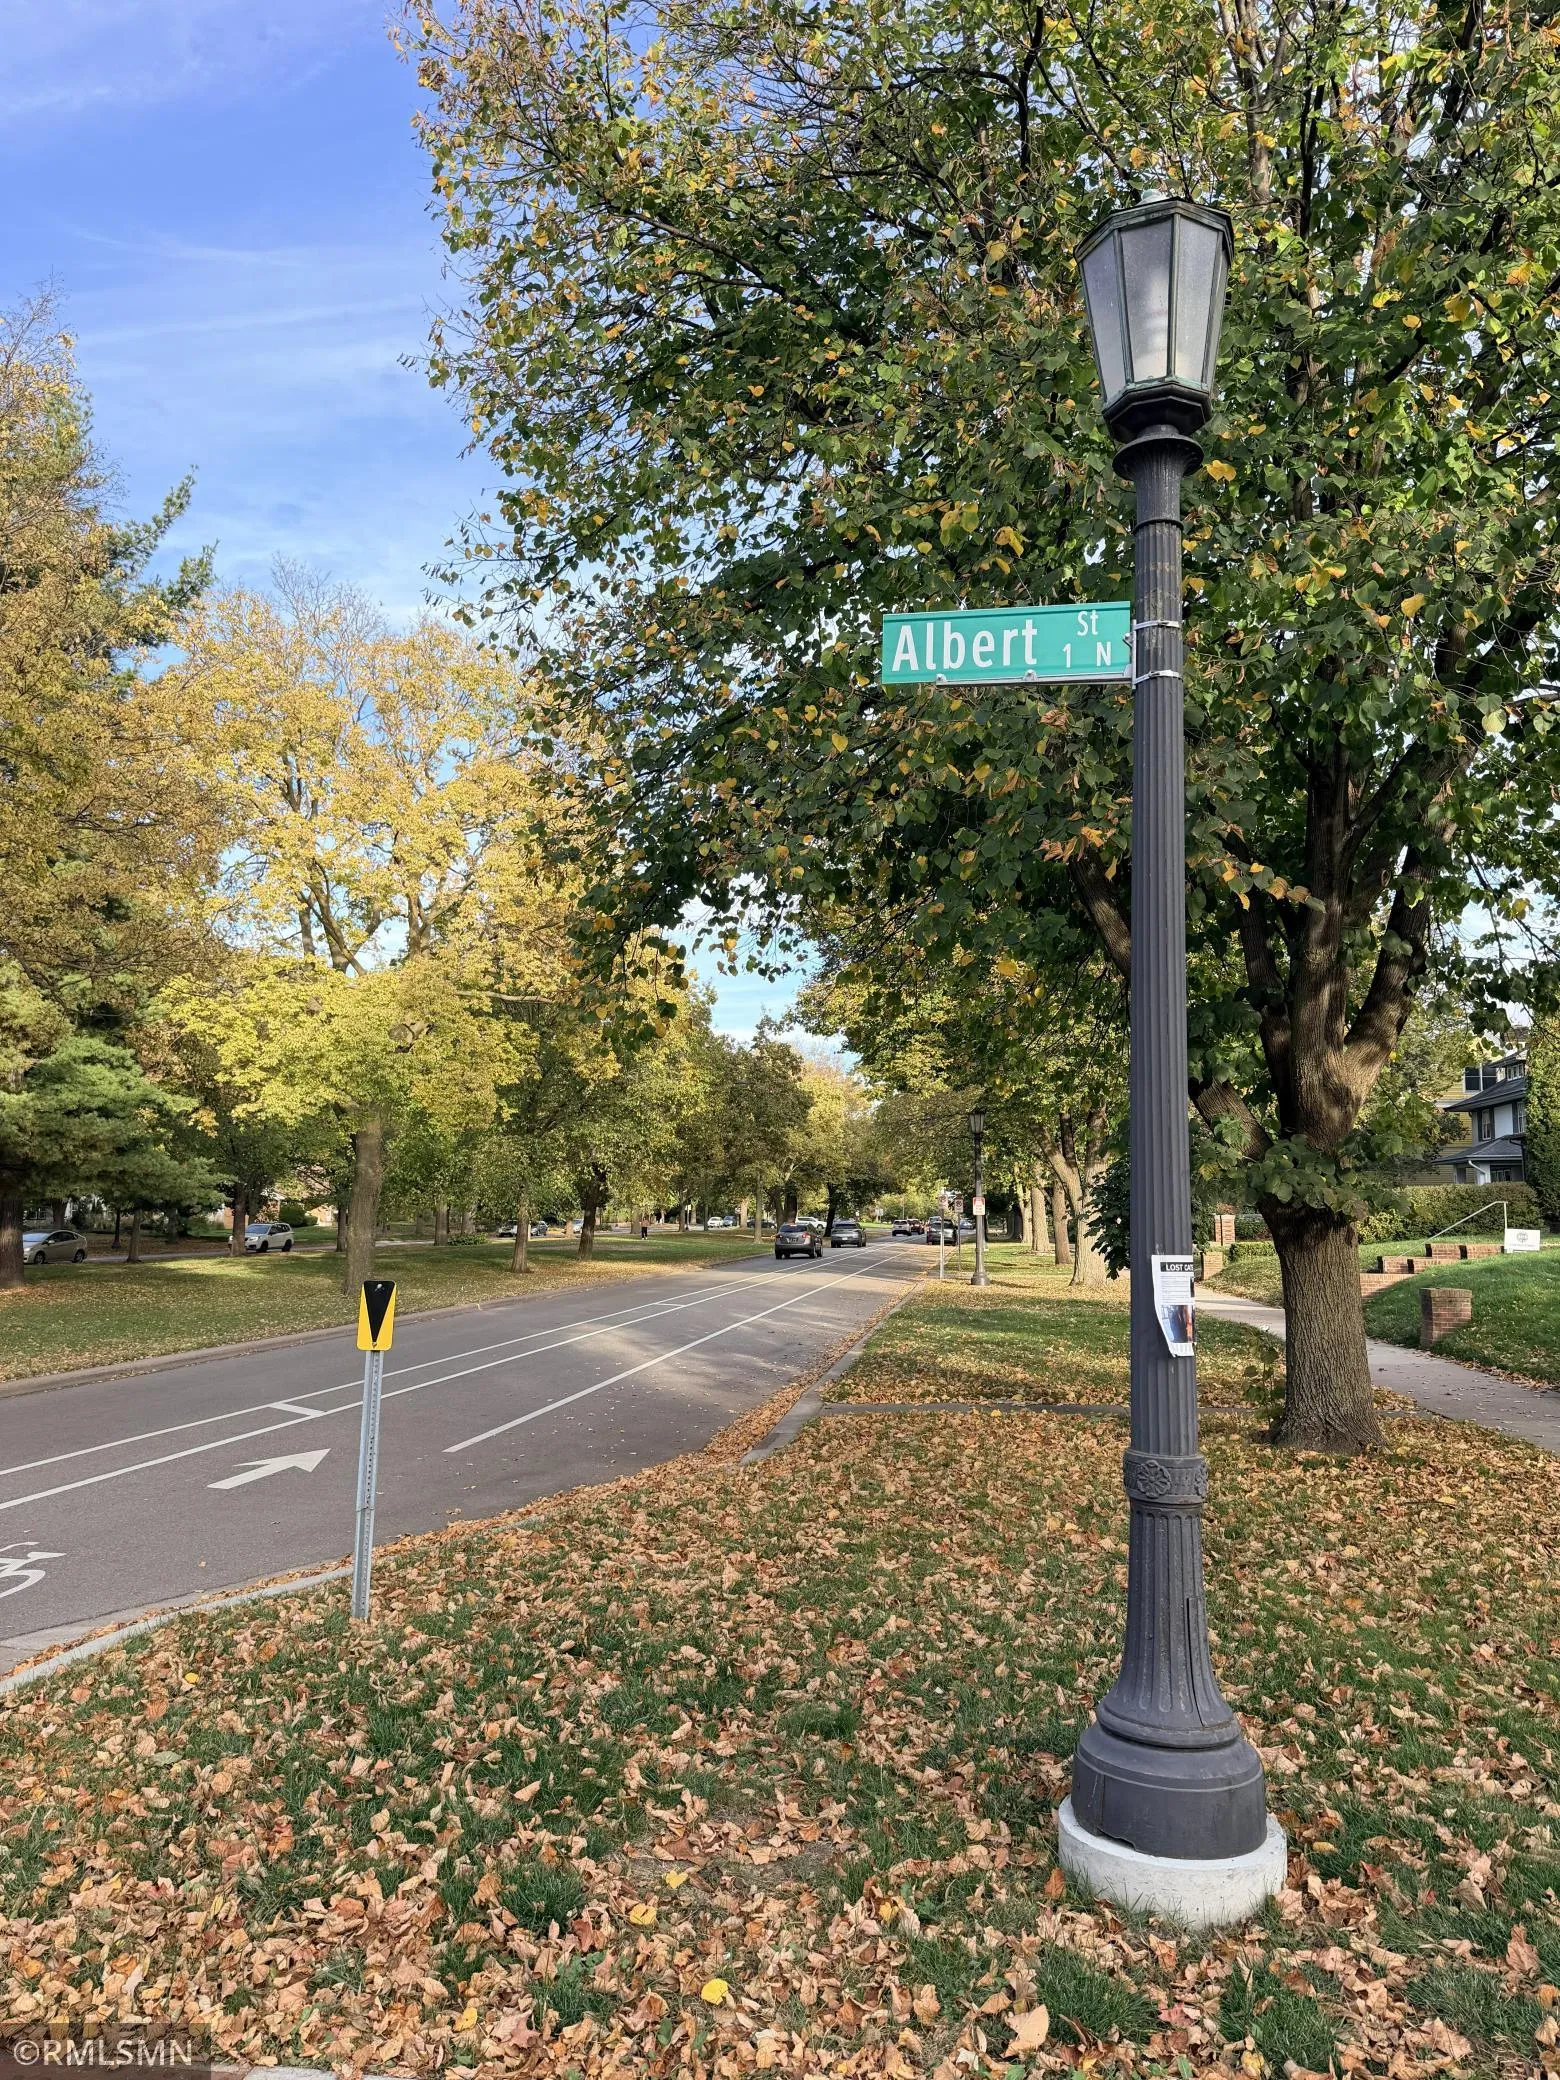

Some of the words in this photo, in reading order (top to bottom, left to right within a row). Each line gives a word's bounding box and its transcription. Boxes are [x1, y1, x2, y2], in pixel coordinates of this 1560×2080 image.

[892, 619, 1037, 672] Albert
[1077, 610, 1099, 636] St
[1062, 643, 1071, 668] 1
[1096, 641, 1112, 666] N
[1166, 1263, 1183, 1271] LOST
